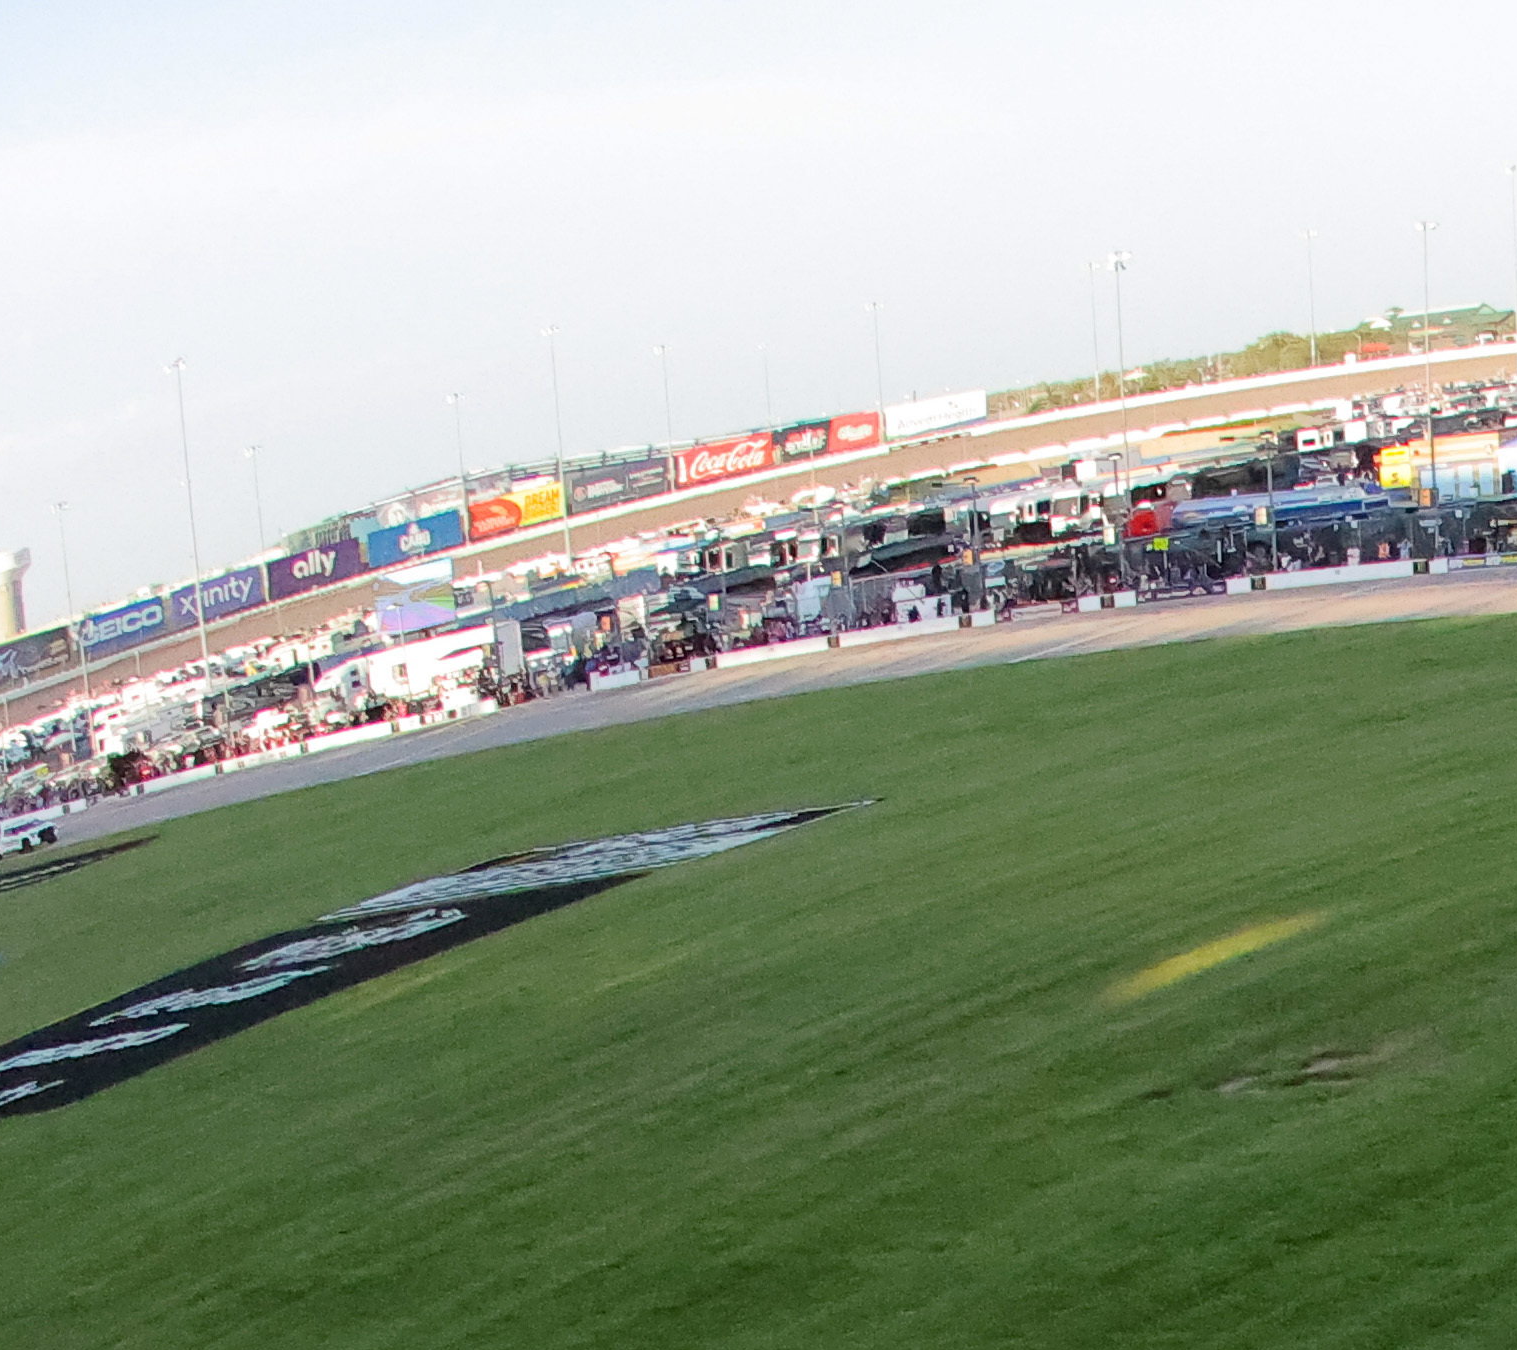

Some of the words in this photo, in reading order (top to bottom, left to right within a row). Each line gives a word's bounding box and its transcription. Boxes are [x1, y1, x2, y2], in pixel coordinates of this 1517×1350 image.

[689, 438, 770, 478] Coca-Cola
[290, 550, 336, 581] ally
[81, 605, 163, 648] GEICO
